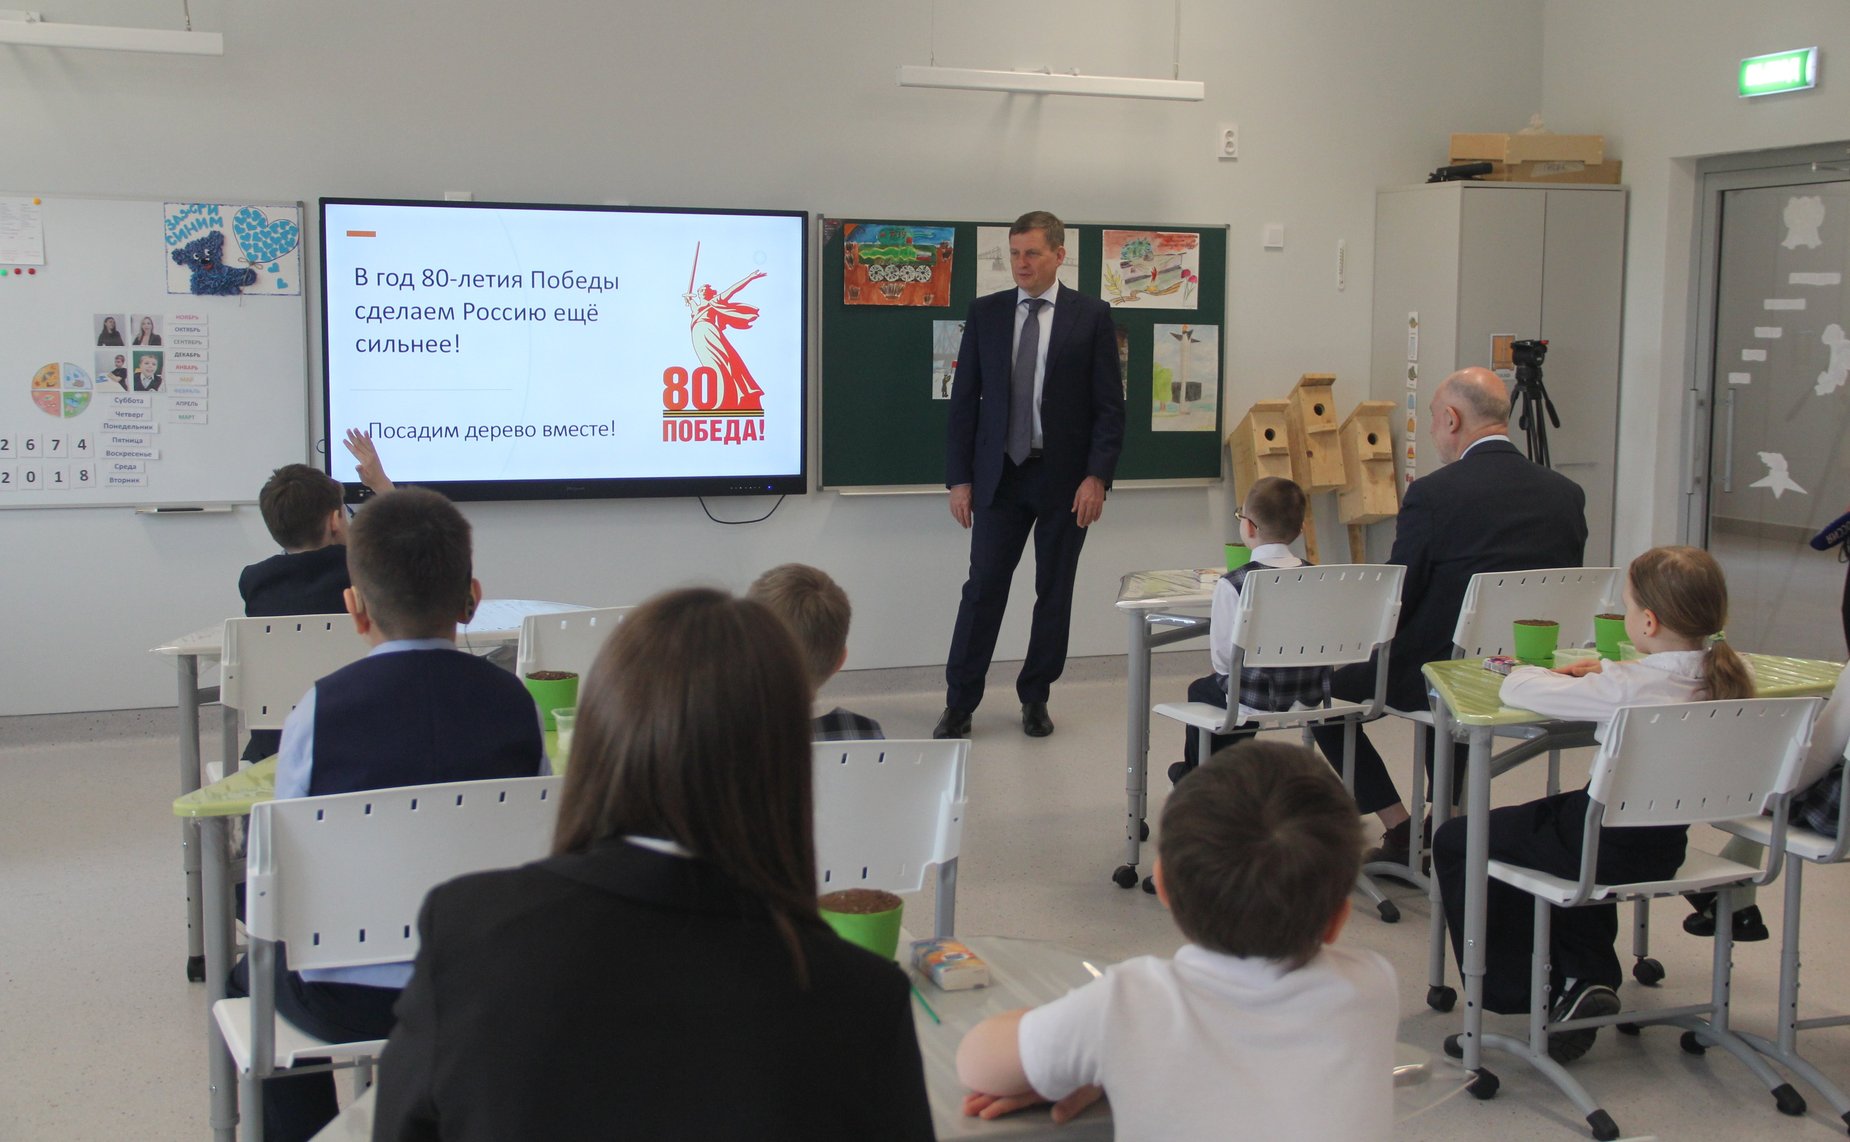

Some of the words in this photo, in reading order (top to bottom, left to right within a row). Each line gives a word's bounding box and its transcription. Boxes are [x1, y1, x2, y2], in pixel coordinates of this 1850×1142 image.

[165, 216, 223, 246] СИНИМ
[354, 267, 369, 286] В
[376, 272, 415, 291] год
[421, 268, 523, 289] 80-летия
[530, 270, 620, 293] Победы
[354, 304, 456, 324] сделаем
[463, 302, 547, 322] Россию
[553, 304, 599, 326] ещё
[355, 333, 461, 354] сильнее!
[662, 365, 718, 411] 80
[114, 396, 144, 405] Суббота
[115, 411, 144, 419] Четверг
[368, 421, 460, 442] Посадим
[464, 423, 537, 442] дерево
[542, 419, 616, 438] вместе!
[662, 418, 766, 446] ПОБЕДА!
[26, 439, 35, 451] 6
[51, 439, 61, 451] 7
[77, 439, 87, 451] 4
[112, 436, 144, 445] Пятница
[105, 450, 153, 459] Воскресенье
[114, 463, 137, 471] Среда
[1, 472, 11, 484] 2
[26, 471, 36, 483] 0
[54, 471, 63, 483] 1
[79, 469, 89, 482] 8
[109, 476, 141, 485] Вторник
